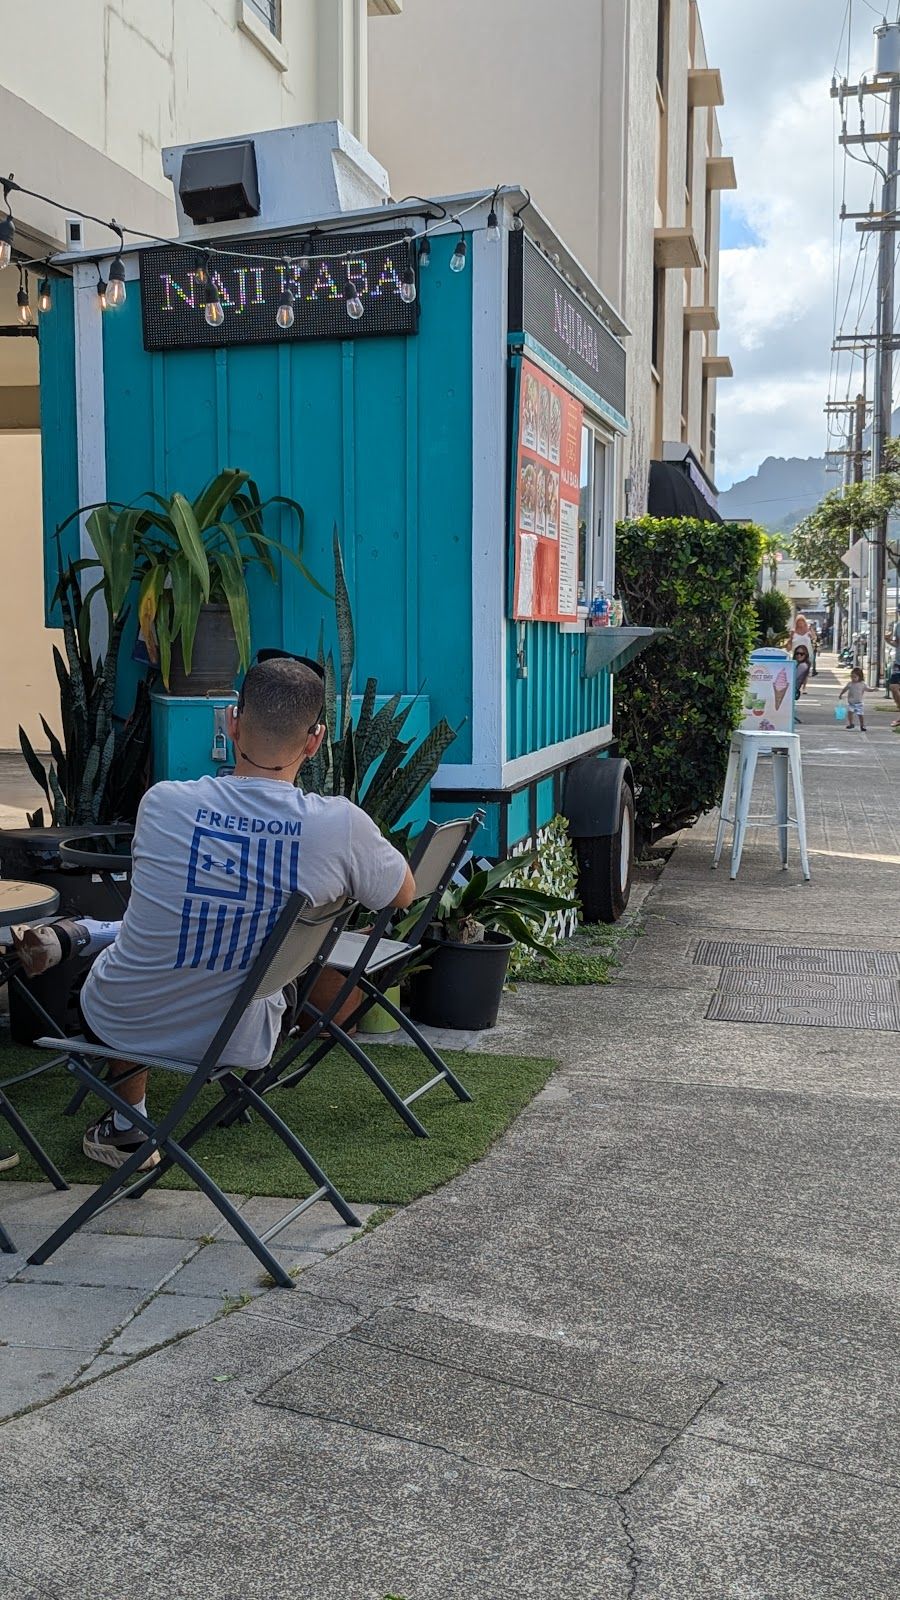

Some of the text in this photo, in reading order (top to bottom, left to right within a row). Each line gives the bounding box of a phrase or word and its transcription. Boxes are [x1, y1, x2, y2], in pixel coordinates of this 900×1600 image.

[160, 258, 403, 314] NAJI BABA
[196, 808, 302, 836] FREEDOM
